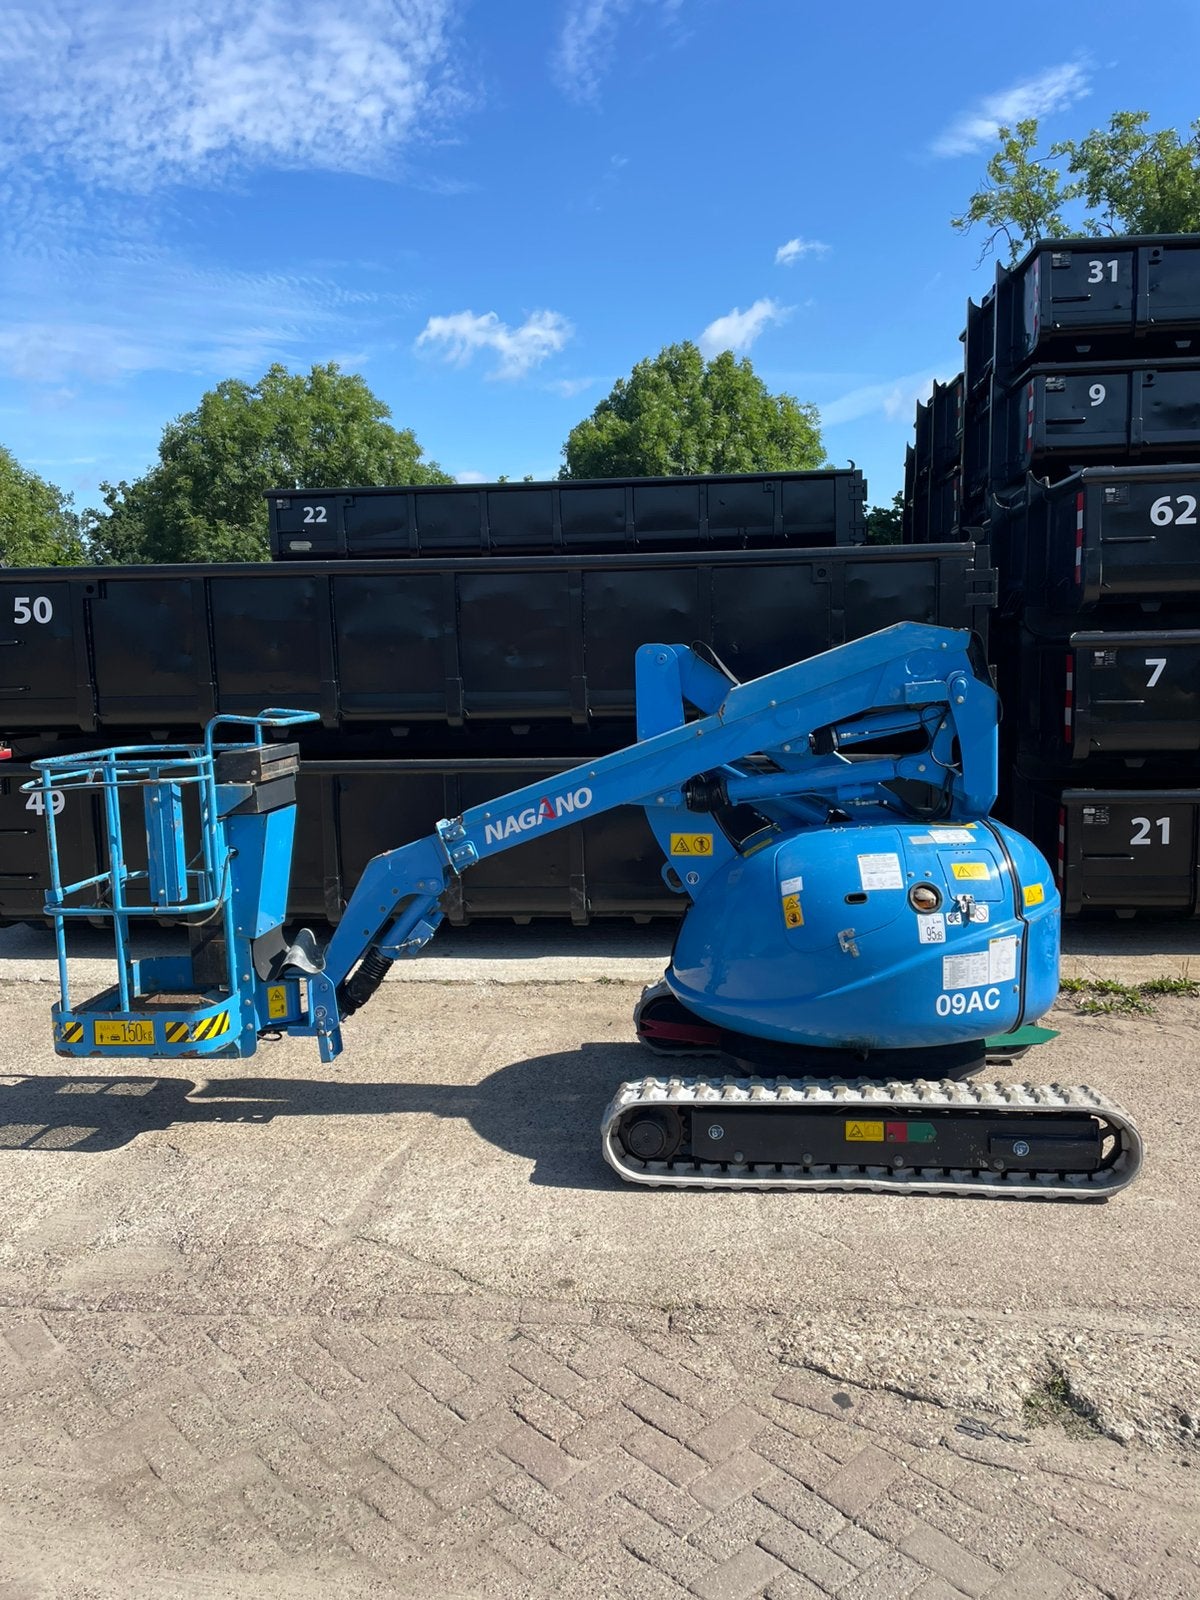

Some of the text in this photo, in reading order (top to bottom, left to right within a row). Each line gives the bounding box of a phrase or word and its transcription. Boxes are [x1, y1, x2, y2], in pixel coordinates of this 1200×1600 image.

[1088, 260, 1118, 283] 31
[1089, 384, 1106, 406] 9
[303, 506, 328, 523] 22
[1150, 495, 1197, 526] 62
[13, 597, 53, 625] 50
[1145, 658, 1167, 687] 7
[25, 789, 65, 816] 49
[484, 787, 593, 845] NAGANO
[1130, 817, 1170, 845] 21
[936, 987, 1000, 1017] 09AC
